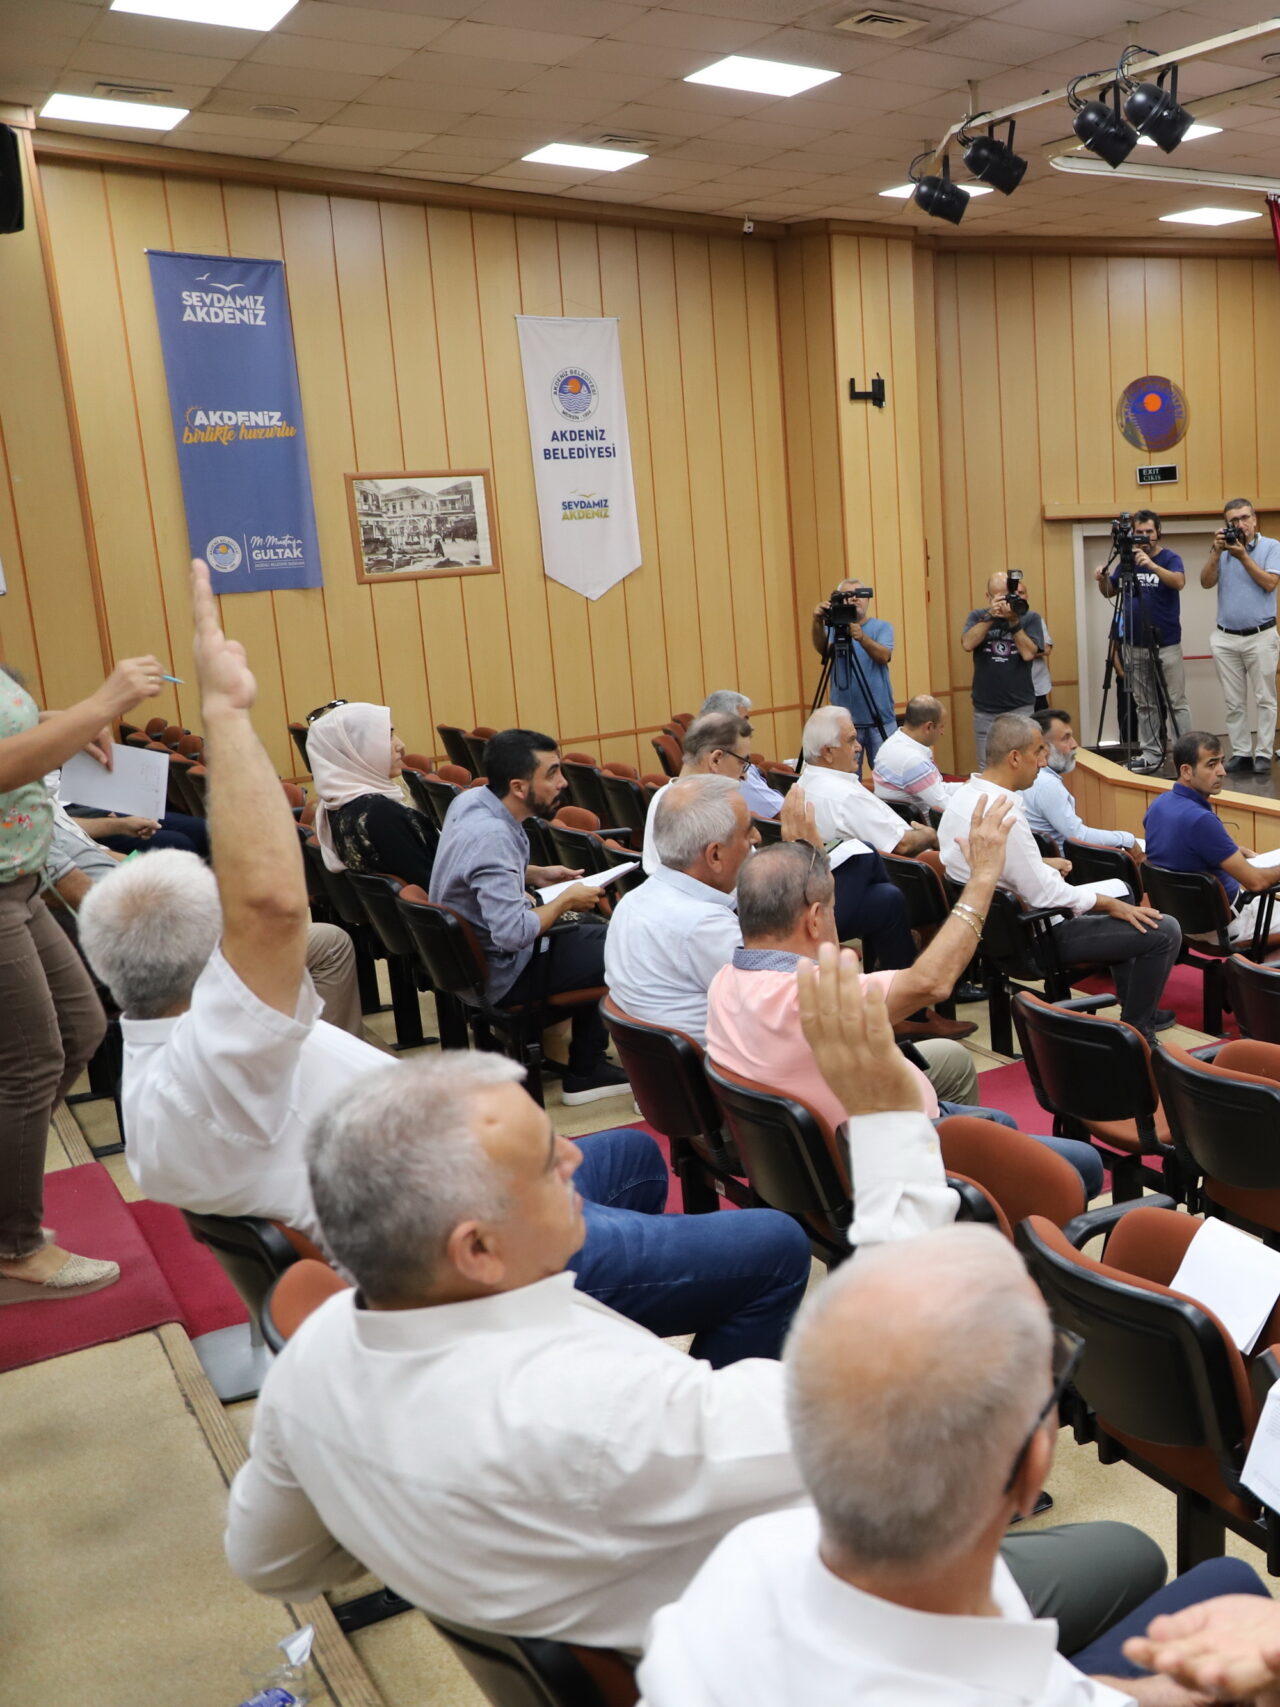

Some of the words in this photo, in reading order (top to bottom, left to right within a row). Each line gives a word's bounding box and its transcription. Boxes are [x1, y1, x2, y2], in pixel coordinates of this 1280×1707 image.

[181, 291, 265, 309] SEVDAMIZ
[182, 306, 267, 326] AKDENİZ
[194, 410, 283, 426] AKDENİZ
[182, 425, 235, 446] birlikte
[239, 421, 297, 441] huzurlu
[551, 426, 606, 442] AKDENİZ
[543, 443, 616, 460] BELEDİYESİ
[562, 499, 609, 511] SEVDAMIZ
[562, 508, 609, 521] AKDENİZ
